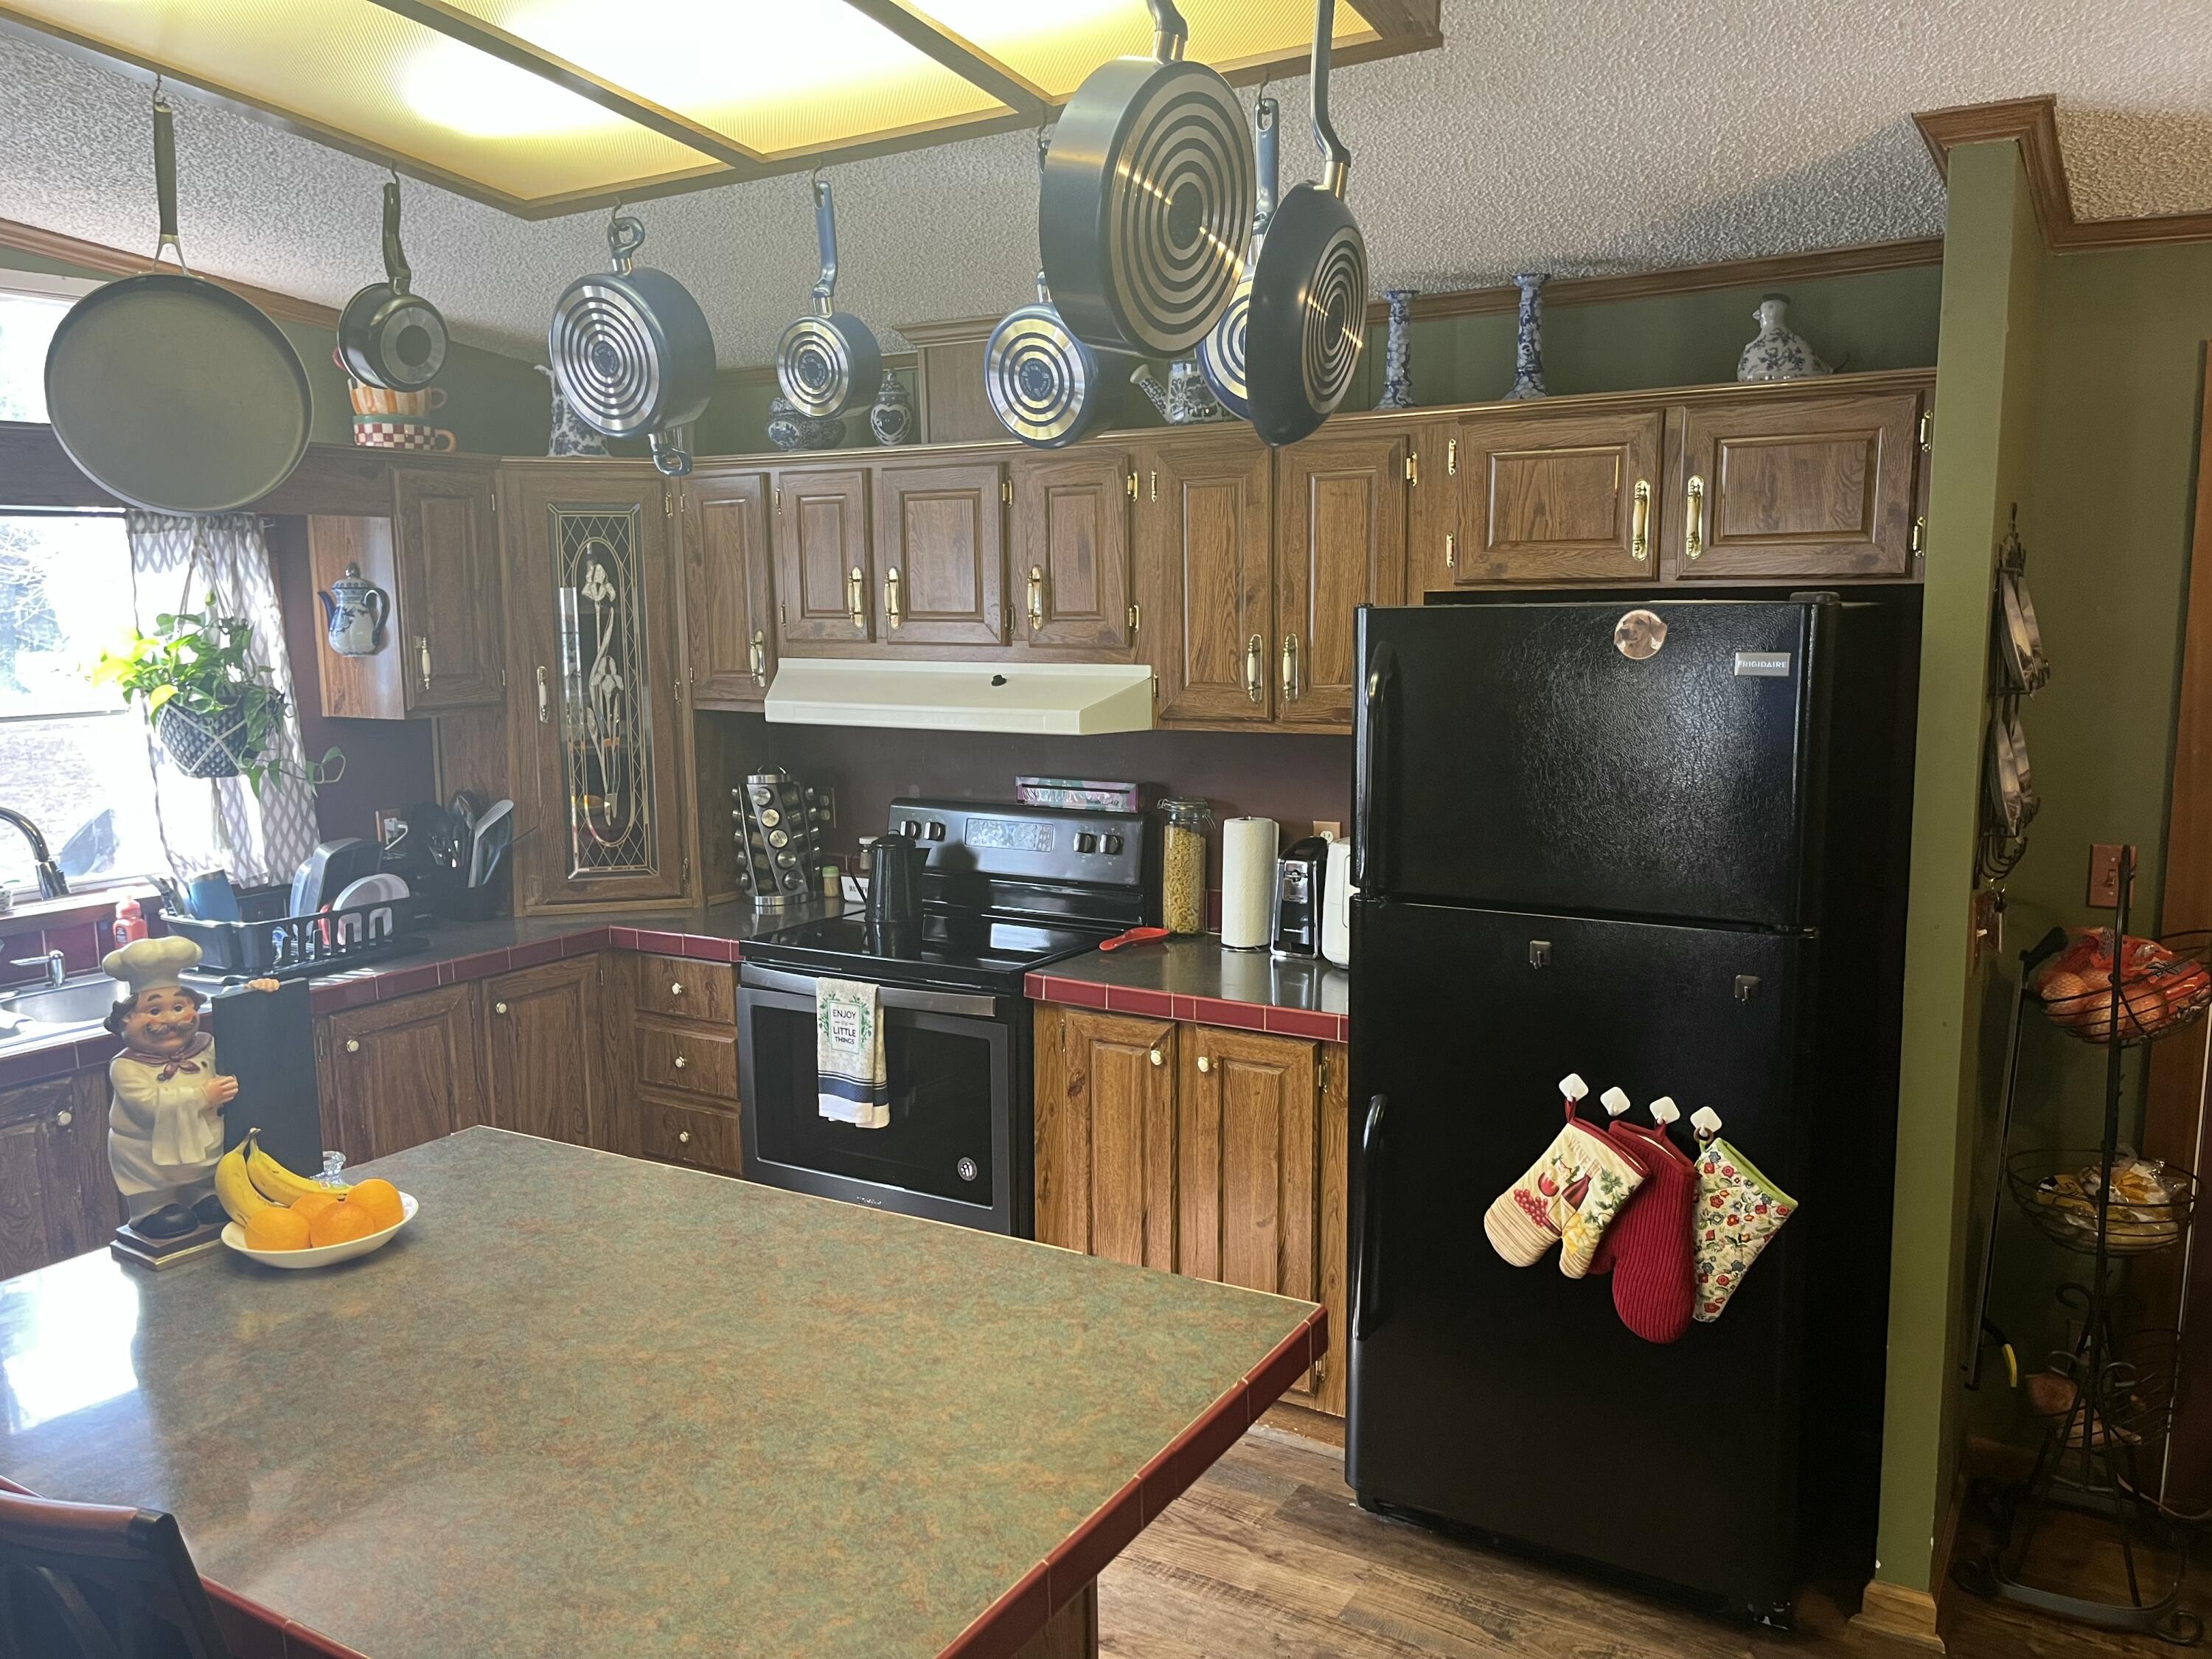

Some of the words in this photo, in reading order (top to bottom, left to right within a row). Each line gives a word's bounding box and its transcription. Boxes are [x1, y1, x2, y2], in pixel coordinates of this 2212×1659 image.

[832, 1009, 856, 1019] ENJOY
[833, 1026, 856, 1037] LITTLE
[835, 1036, 855, 1045] THINGS
